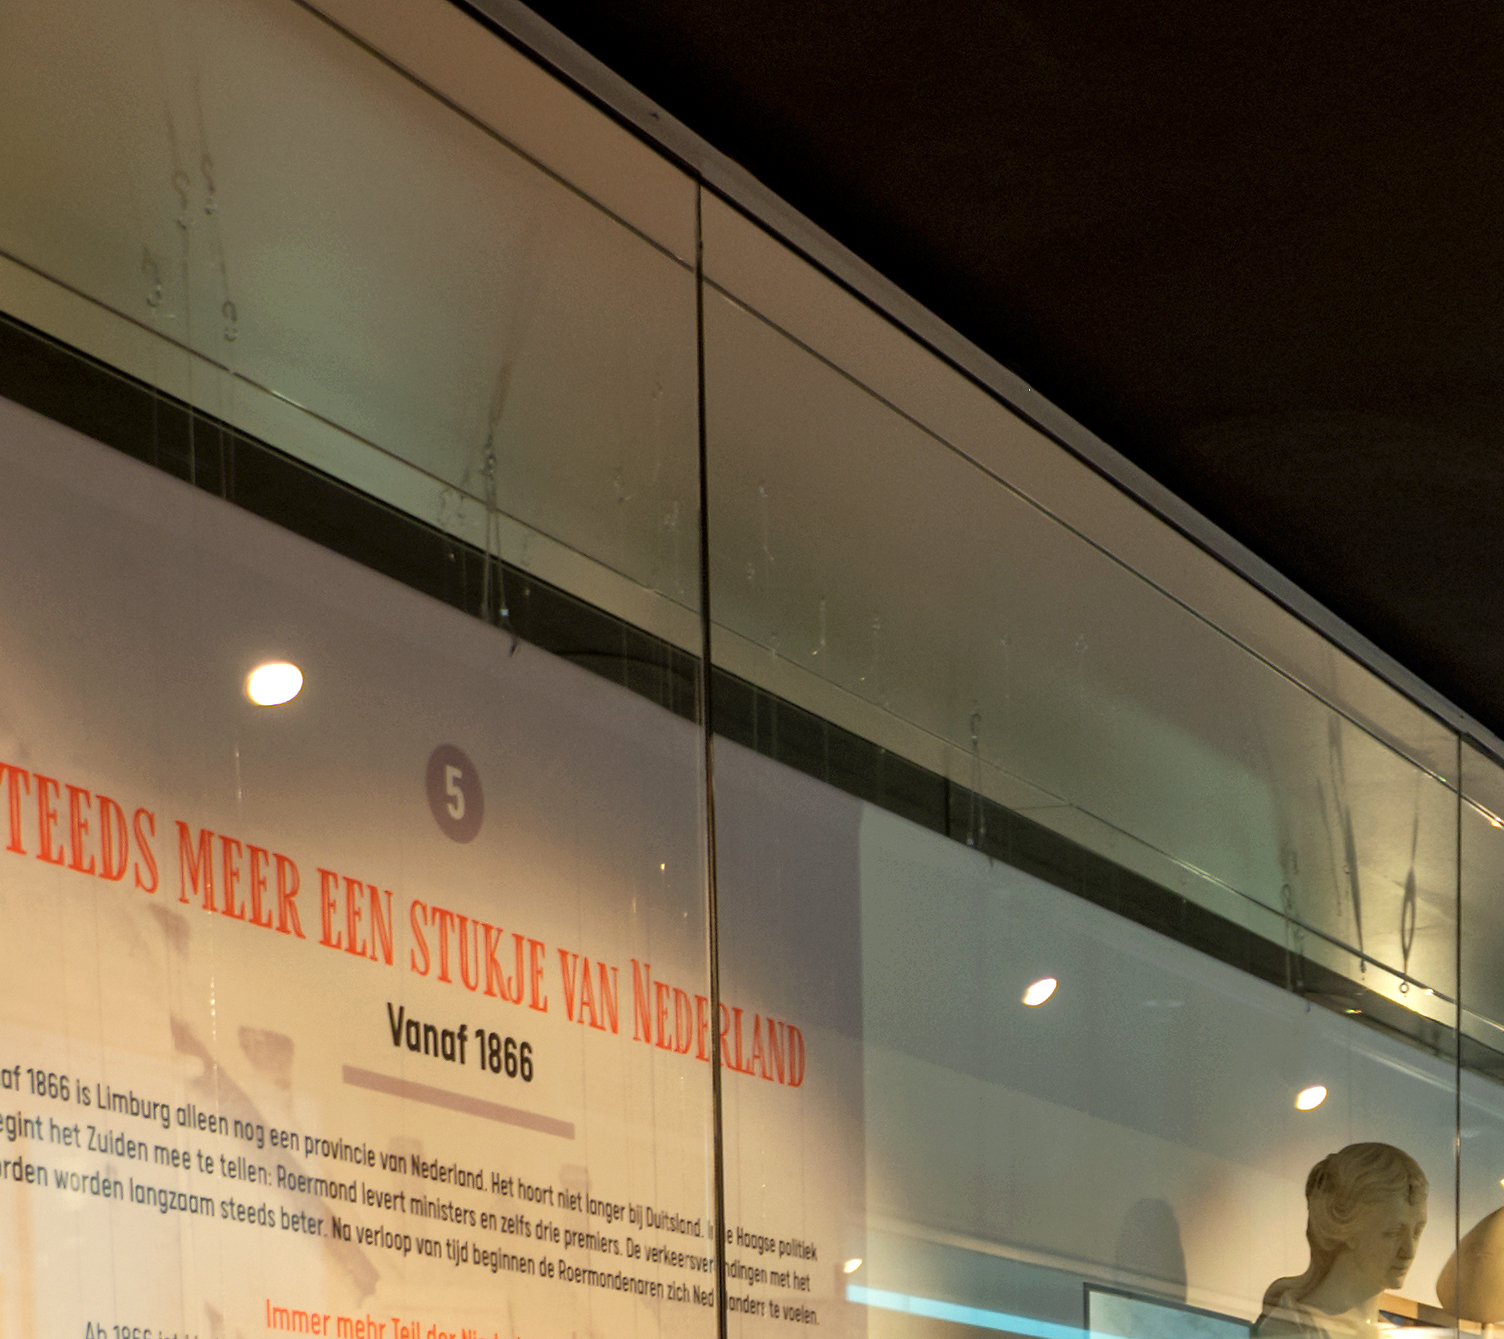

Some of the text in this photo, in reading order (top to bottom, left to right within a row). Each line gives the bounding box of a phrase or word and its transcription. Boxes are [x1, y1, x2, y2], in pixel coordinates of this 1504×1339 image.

[438, 765, 466, 820] 5
[175, 820, 306, 940] MEER
[316, 867, 394, 966] EEN
[409, 899, 549, 1013] STUKJE
[557, 948, 619, 1035] VAN
[386, 1003, 534, 1083] Vanaf 1866
[26, 1068, 71, 1102] 1866
[76, 1078, 91, 1106] is
[96, 1082, 171, 1130] Limburg
[175, 1103, 229, 1136] alleen
[233, 1119, 265, 1149] nog
[269, 1128, 300, 1151] een
[304, 1135, 376, 1168] provincie
[379, 1151, 407, 1174] van
[411, 1153, 488, 1192] Nederland.
[491, 1171, 514, 1198] Het
[517, 1177, 554, 1206] hoort
[557, 1188, 583, 1212] niet
[585, 1192, 625, 1224] langer
[628, 1202, 644, 1230] bij
[646, 1206, 705, 1238] Duitsland.
[736, 1226, 776, 1255] Haagse
[778, 1240, 817, 1260] politiek
[49, 1117, 81, 1148] het
[86, 1124, 149, 1162] Zuiden
[154, 1144, 191, 1170] mee
[196, 1149, 215, 1175] te
[219, 1153, 272, 1186] tellen:
[276, 1163, 357, 1203] Roermond
[361, 1181, 406, 1213] levert
[409, 1194, 476, 1227] ministers
[479, 1212, 497, 1231] en
[500, 1214, 532, 1238] zelfs
[535, 1218, 561, 1244] drie
[564, 1229, 623, 1256] premiers.
[626, 1236, 641, 1260] De
[770, 1270, 791, 1288] met
[793, 1270, 811, 1292] het
[54, 1169, 124, 1200] worden
[129, 1176, 215, 1217] langzaam
[220, 1197, 276, 1228] steeds
[280, 1205, 328, 1237] beter.
[331, 1215, 352, 1242] Na
[355, 1224, 412, 1257] verloop
[415, 1237, 443, 1258] van
[445, 1238, 469, 1267] tijd
[472, 1242, 535, 1275] beginnen
[538, 1255, 555, 1279] de
[558, 1258, 664, 1298] Roermondenaren
[667, 1280, 690, 1302] zich
[768, 1299, 780, 1319] te
[266, 1298, 332, 1337] Immer
